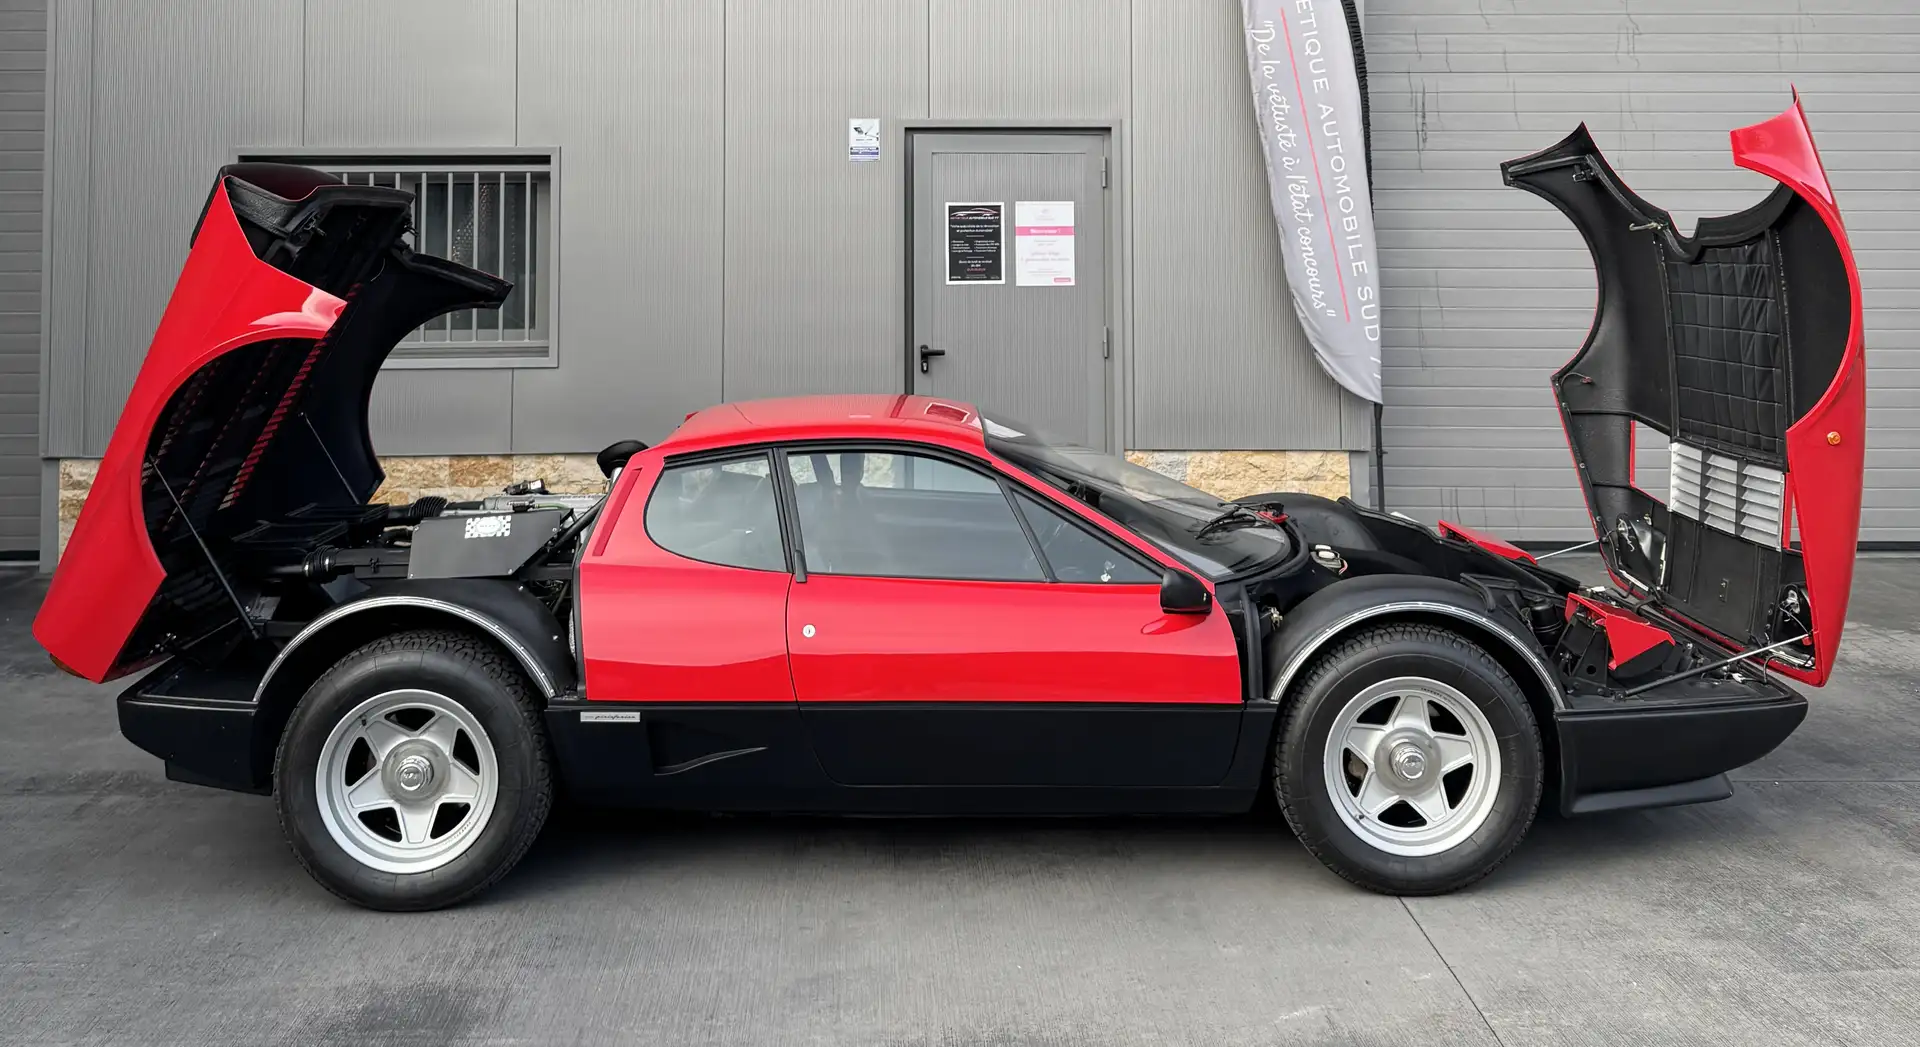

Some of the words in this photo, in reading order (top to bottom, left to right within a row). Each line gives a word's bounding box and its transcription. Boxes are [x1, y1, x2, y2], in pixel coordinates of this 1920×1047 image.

[1260, 60, 1281, 80] la
[1282, 156, 1301, 172] à
[1295, 0, 1330, 94] ETIQUE
[1317, 103, 1369, 277] AUTOMOBILE
[1357, 286, 1380, 342] SUD
[1285, 175, 1315, 224] l'état
[1297, 226, 1337, 317] concours"
